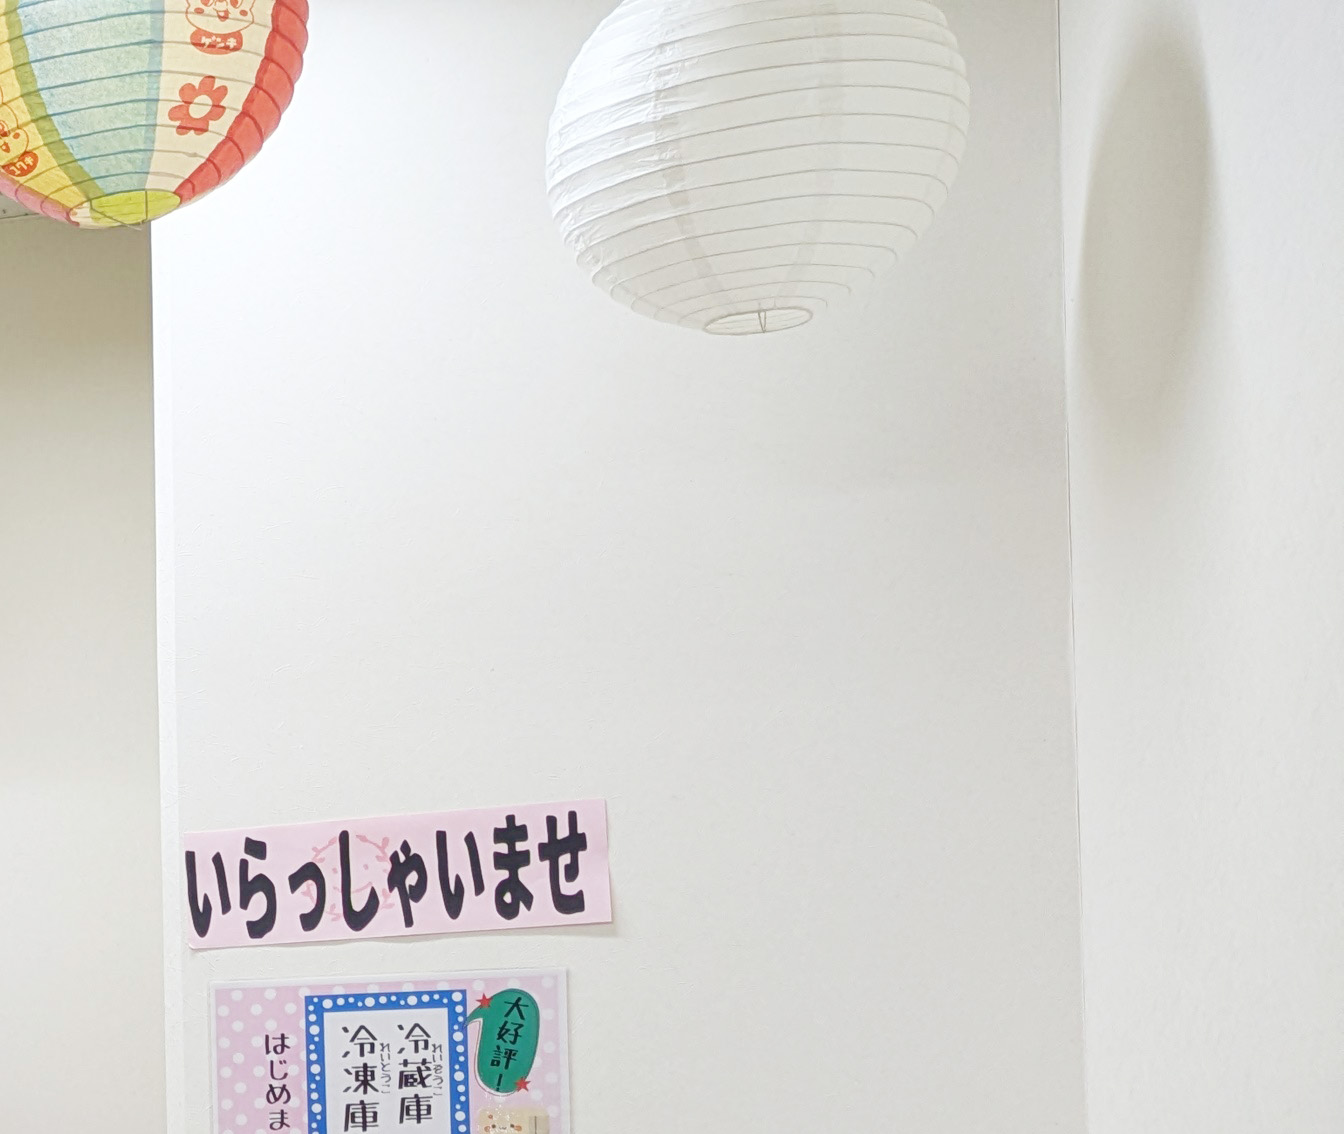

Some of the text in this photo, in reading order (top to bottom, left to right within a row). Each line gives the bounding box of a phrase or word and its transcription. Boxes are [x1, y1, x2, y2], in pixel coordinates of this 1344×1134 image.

[184, 810, 588, 940] いらっしゃいませ
[340, 1023, 381, 1133] 冷凍庫
[396, 1022, 434, 1125] 冷蔵庫
